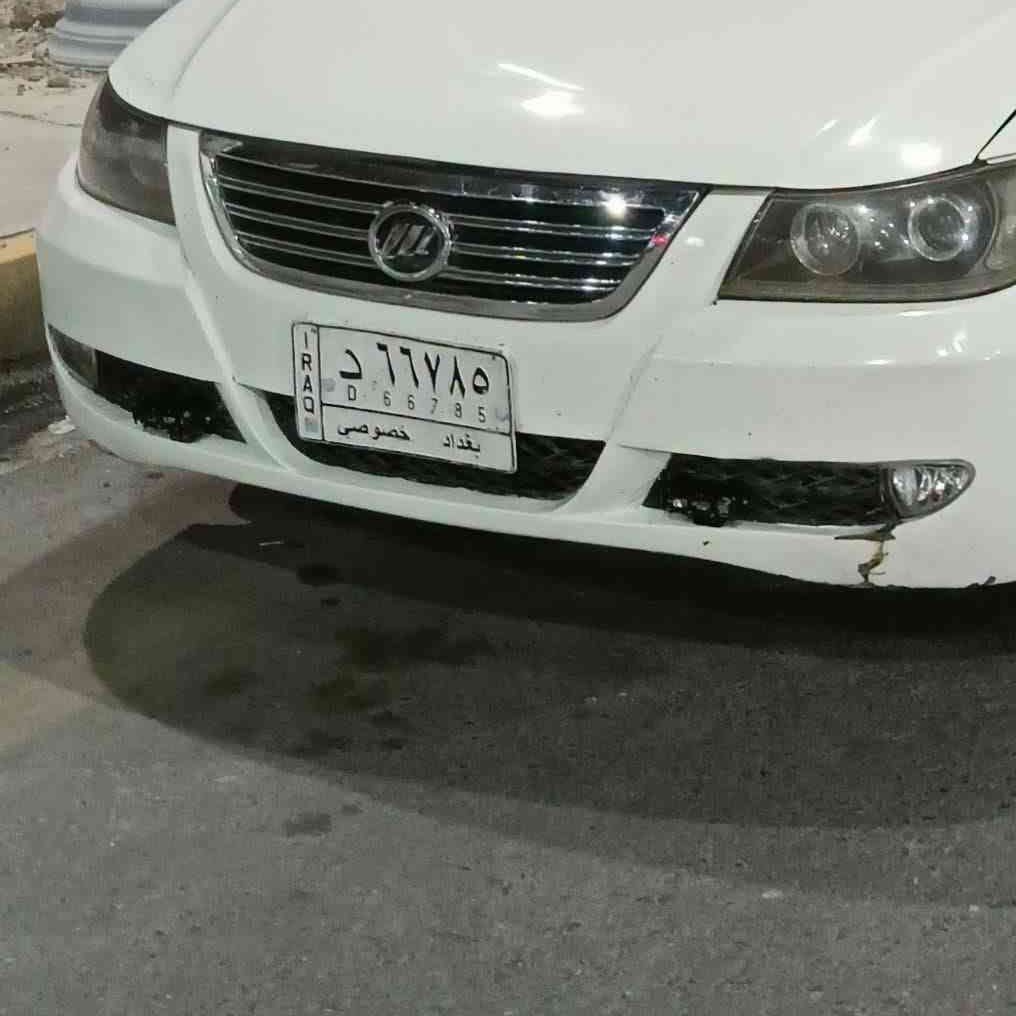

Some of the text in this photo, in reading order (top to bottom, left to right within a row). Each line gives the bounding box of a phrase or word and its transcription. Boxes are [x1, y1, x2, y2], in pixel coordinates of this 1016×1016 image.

[301, 330, 316, 415] IRAQ
[347, 384, 487, 424] D 66785
[443, 434, 481, 459] بغداد
